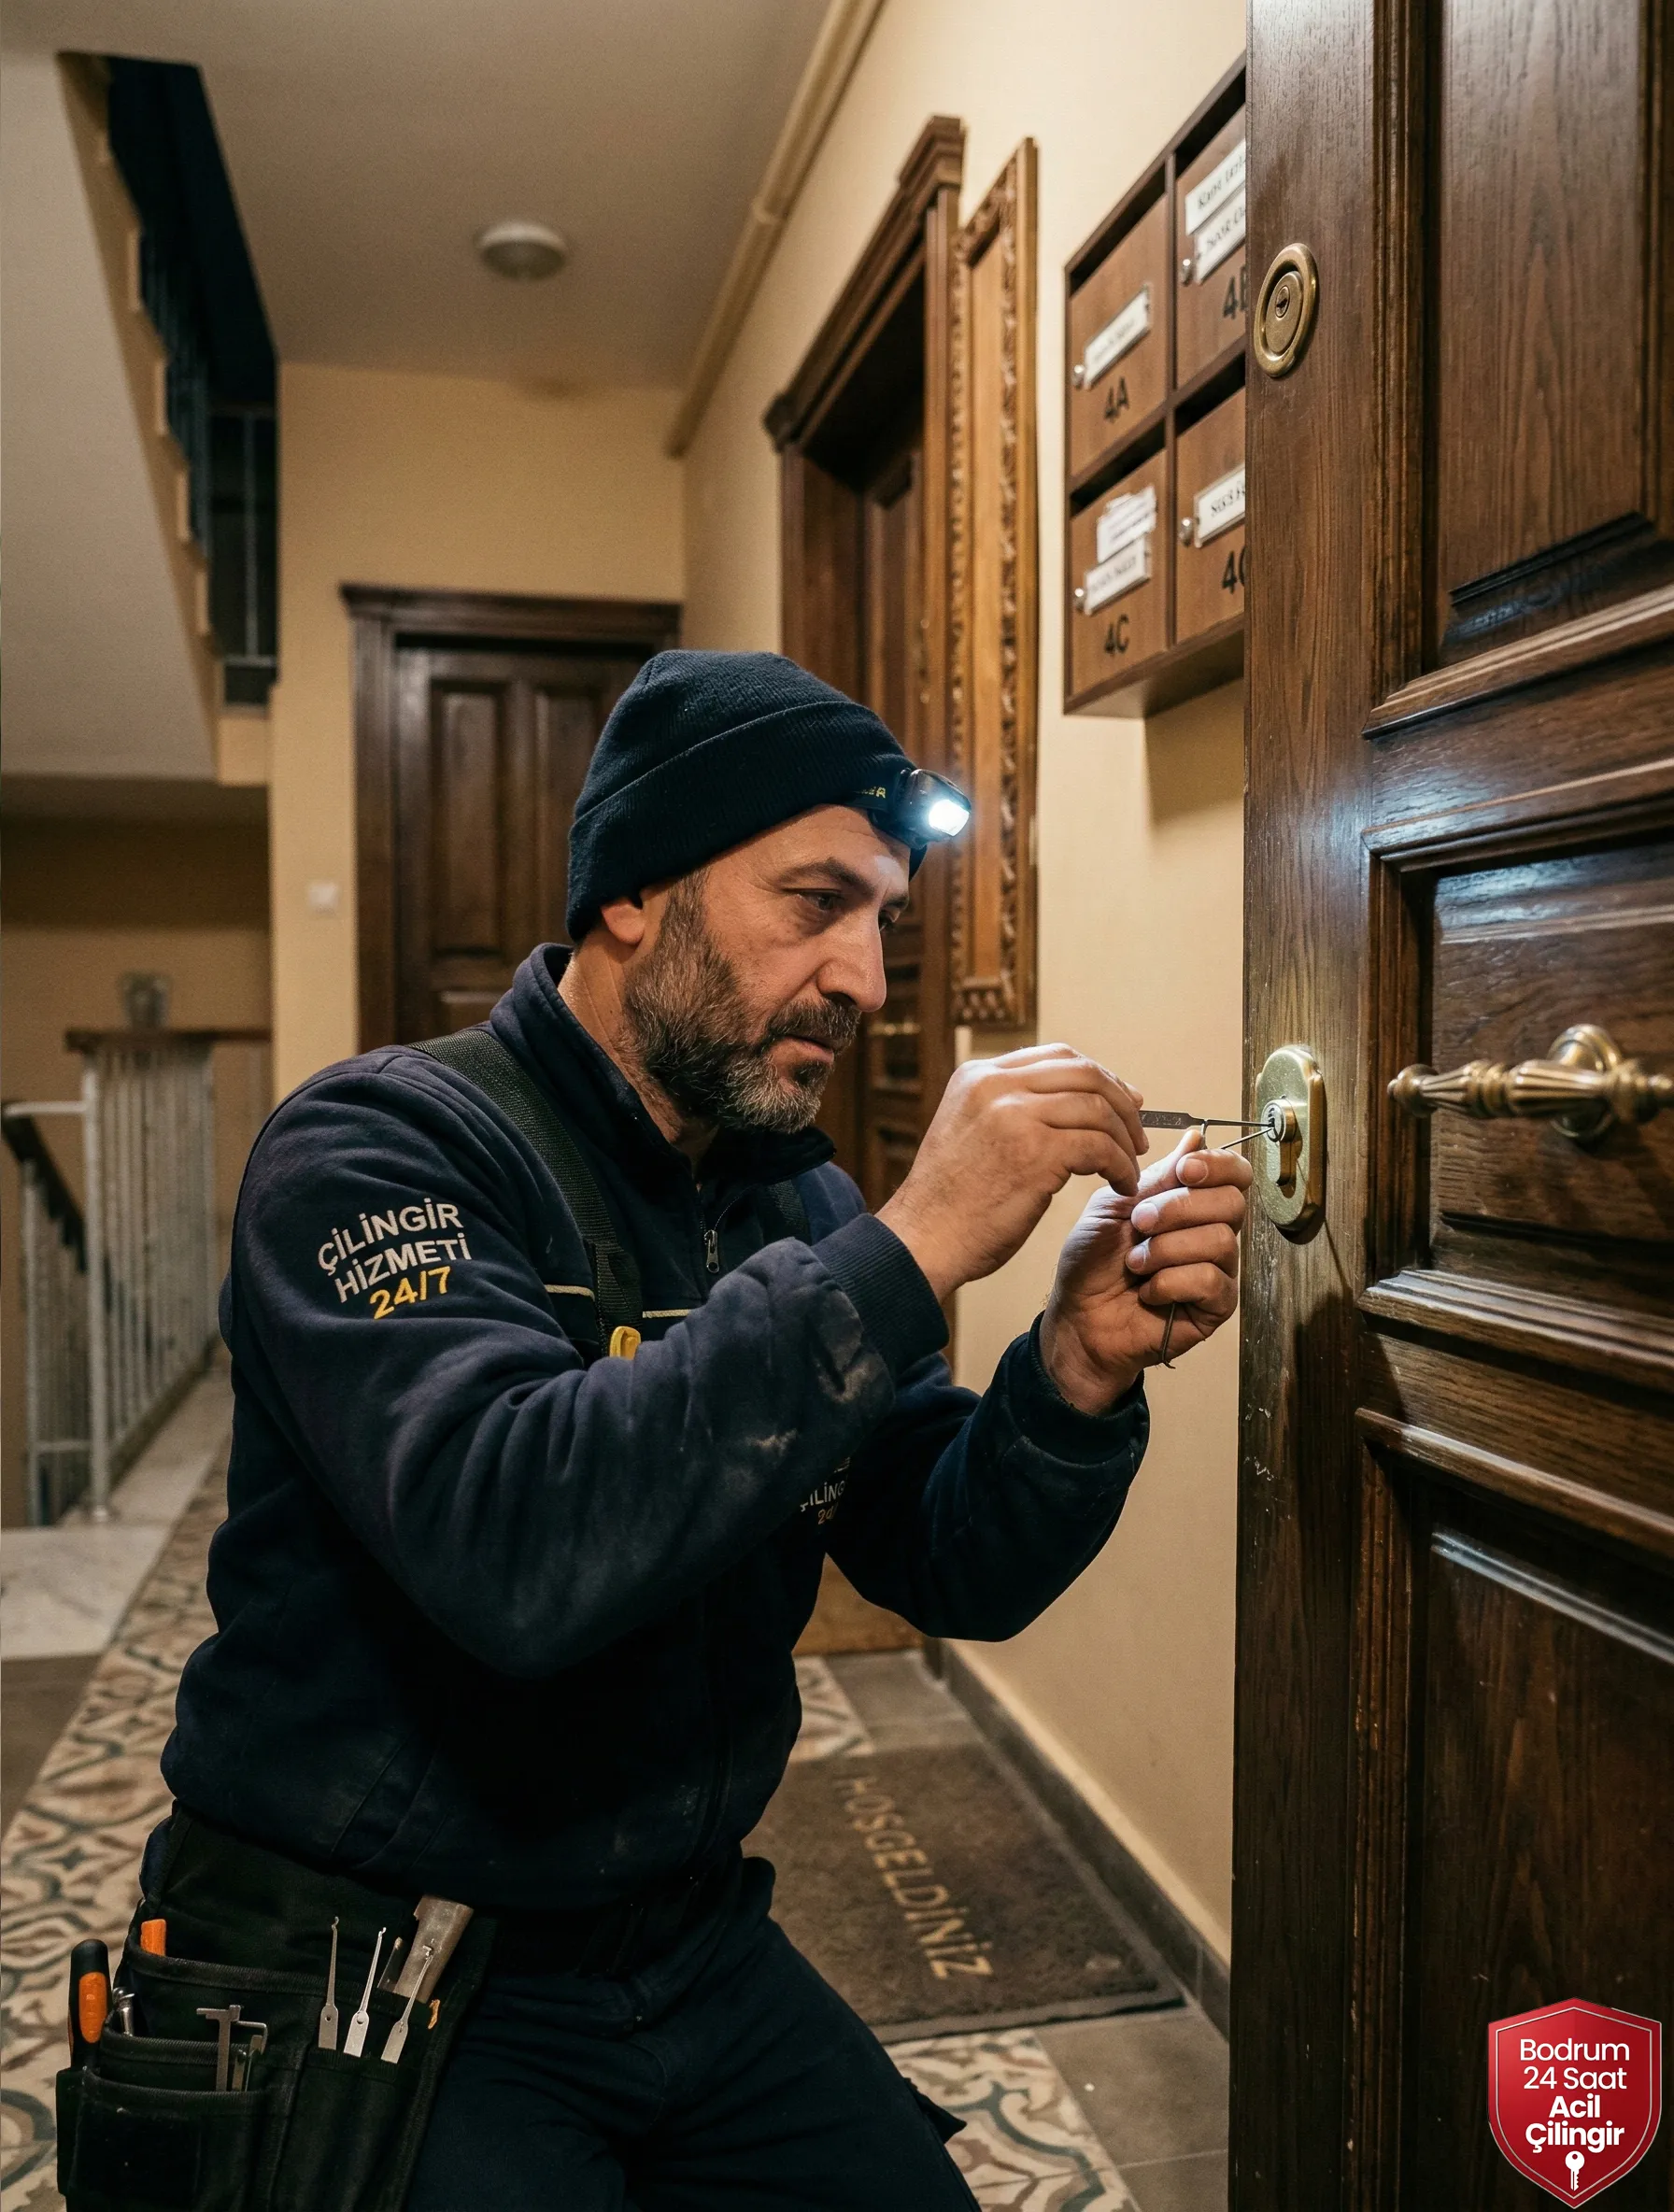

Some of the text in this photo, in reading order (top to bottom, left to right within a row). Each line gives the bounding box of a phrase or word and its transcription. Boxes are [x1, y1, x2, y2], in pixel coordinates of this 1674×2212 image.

[1103, 376, 1130, 424] 4A
[1104, 614, 1129, 657] 4C
[318, 1198, 464, 1276] ÇİLİNGİR
[334, 1232, 472, 1303] HİZMETİ
[369, 1266, 451, 1320] 24/7
